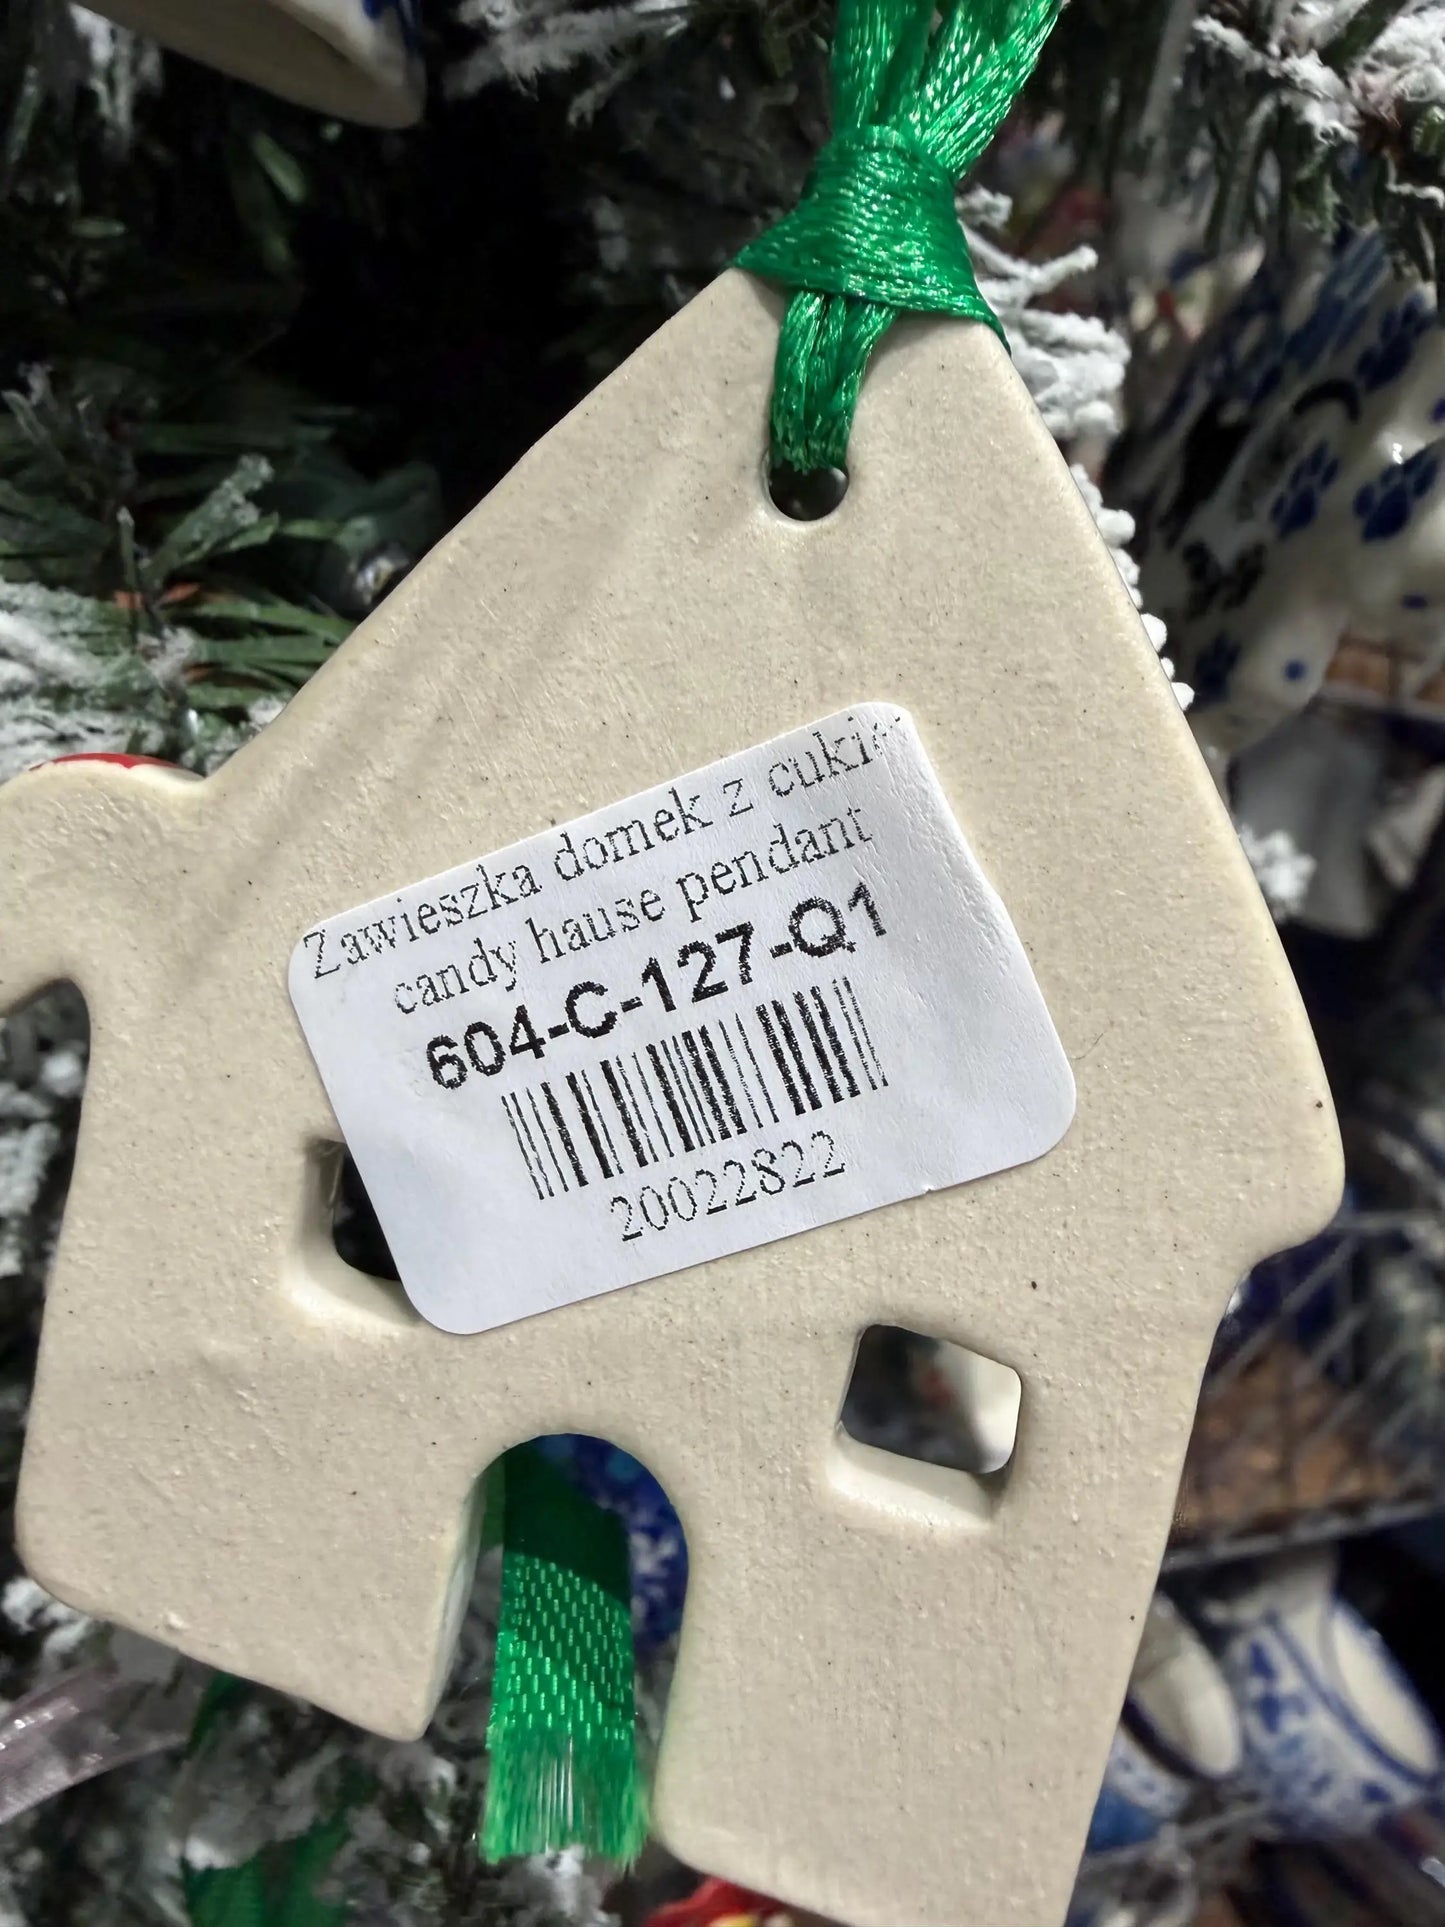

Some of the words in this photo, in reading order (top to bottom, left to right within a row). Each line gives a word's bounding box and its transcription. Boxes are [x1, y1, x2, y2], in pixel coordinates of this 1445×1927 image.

[303, 865, 543, 979] Zawieszka
[553, 787, 713, 881] domek
[722, 778, 754, 817] z
[394, 937, 517, 1015] candy
[525, 889, 666, 964] hause
[675, 806, 874, 924] pendant
[425, 881, 887, 1091] 604-C-127-Q1
[609, 1130, 846, 1242] 20022822
